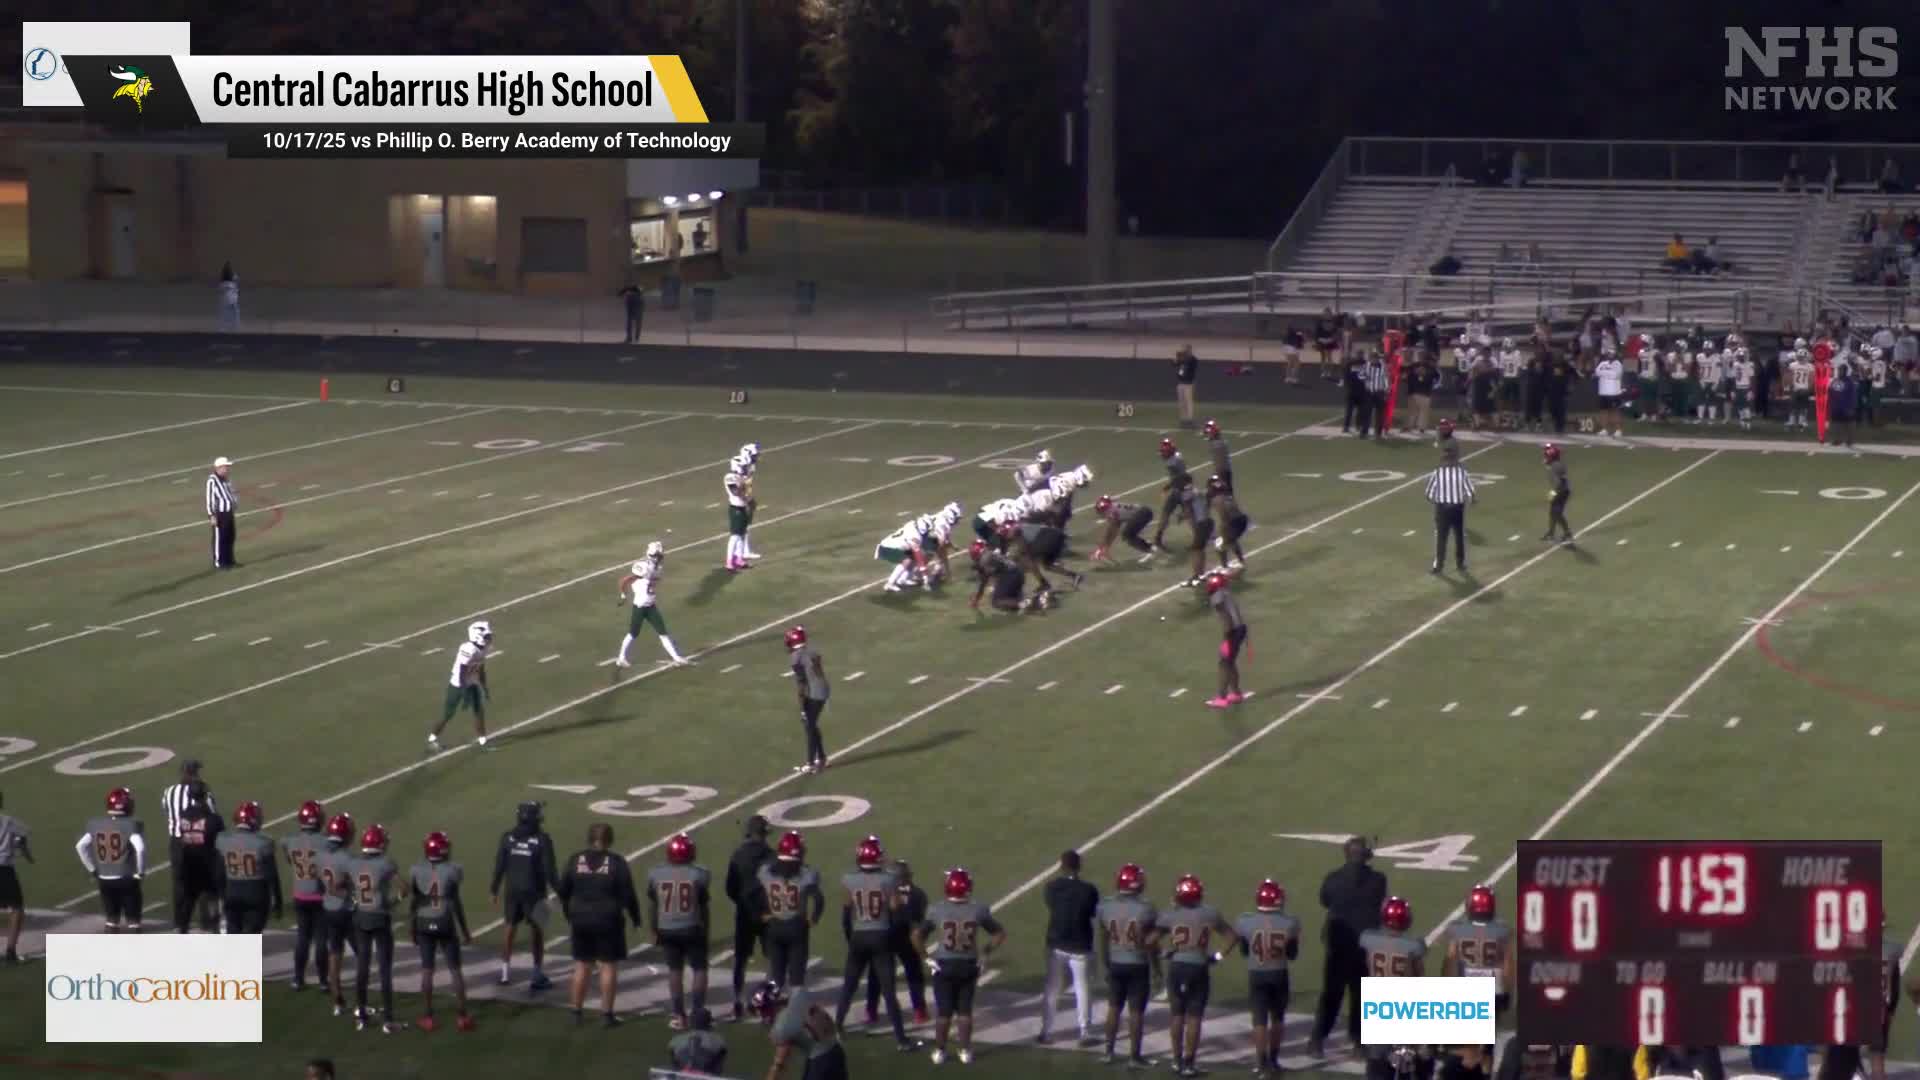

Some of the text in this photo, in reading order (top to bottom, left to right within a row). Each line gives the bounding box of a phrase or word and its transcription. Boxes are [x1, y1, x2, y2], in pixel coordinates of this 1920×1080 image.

[729, 391, 744, 404] 10
[1117, 403, 1134, 417] 20
[588, 783, 871, 828] 30
[96, 832, 125, 864] 69
[1374, 834, 1479, 870] 4
[1534, 856, 1612, 886] GUEST
[1782, 856, 1850, 886] HOME
[358, 873, 375, 904] 2
[660, 881, 692, 914] 78
[853, 890, 883, 921] 10
[1571, 890, 1598, 950] 0
[1815, 890, 1841, 950] 0
[943, 921, 977, 951] 33
[1616, 962, 1637, 983] TO
[1703, 962, 1778, 983] BALL ON
[1639, 986, 1664, 1045] 0
[1739, 986, 1764, 1045] 0
[1834, 987, 1847, 1045] 1
